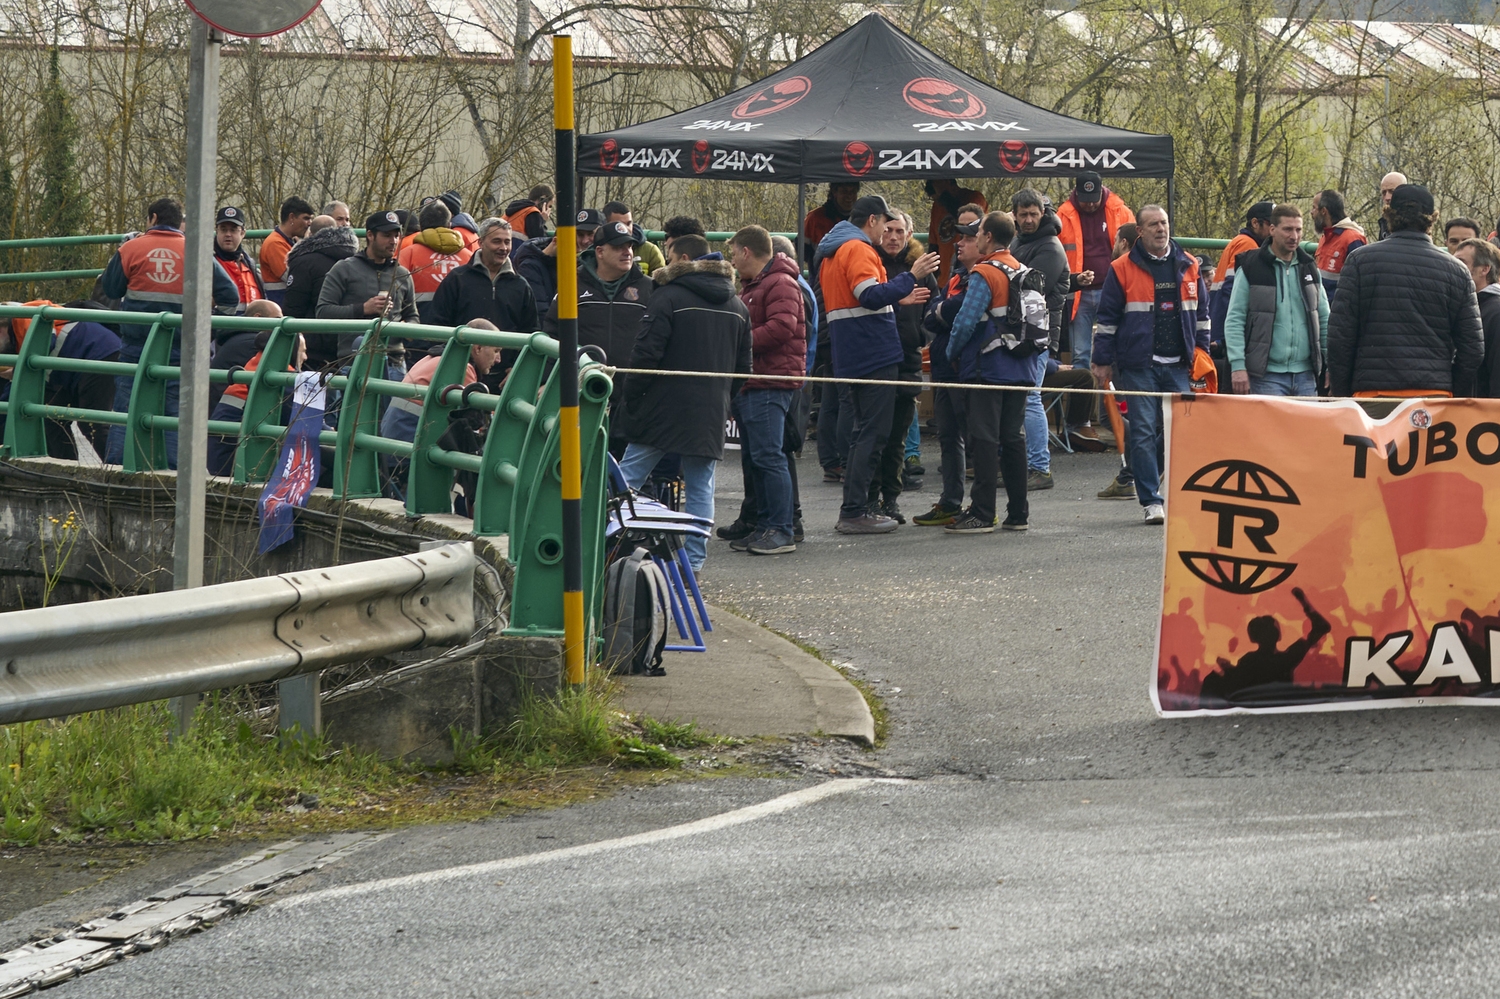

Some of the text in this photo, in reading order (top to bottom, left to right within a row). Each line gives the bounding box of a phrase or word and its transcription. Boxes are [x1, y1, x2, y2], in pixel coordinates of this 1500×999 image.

[682, 119, 764, 132] 24MX
[912, 121, 1031, 133] 24MX
[618, 148, 682, 169] 24MX
[711, 150, 776, 173] 24MX
[878, 148, 984, 170] 24MX
[1033, 147, 1136, 170] 24MX
[149, 257, 176, 274] TR
[1200, 500, 1280, 555] TR
